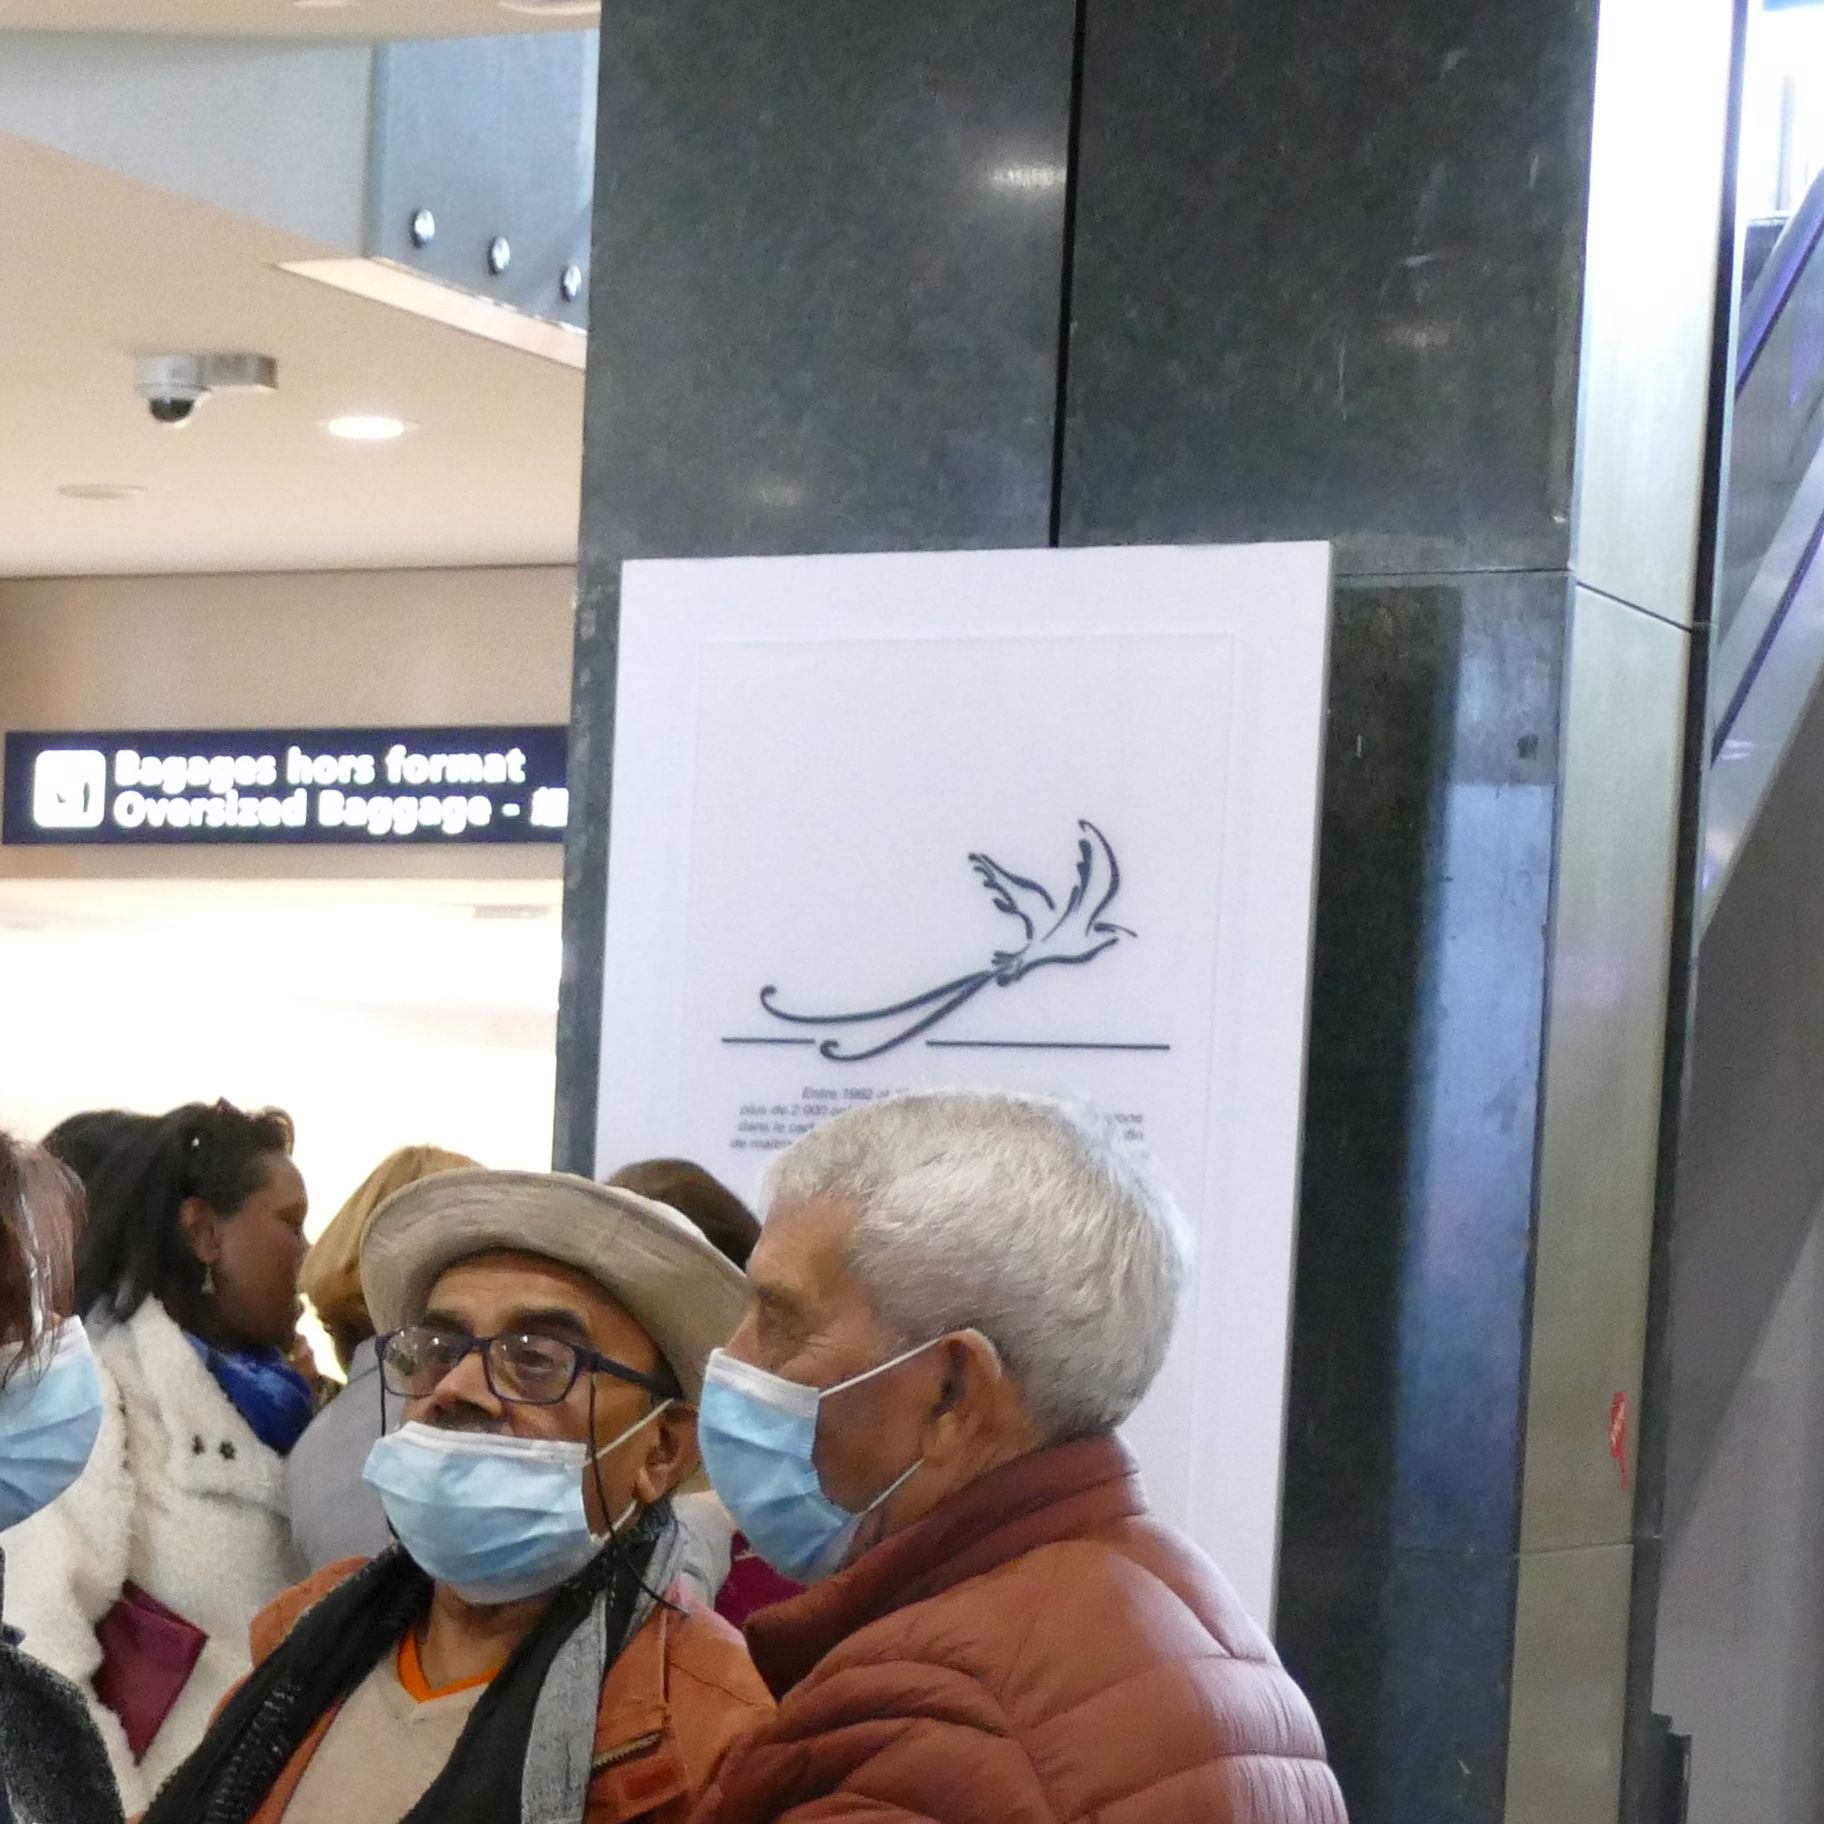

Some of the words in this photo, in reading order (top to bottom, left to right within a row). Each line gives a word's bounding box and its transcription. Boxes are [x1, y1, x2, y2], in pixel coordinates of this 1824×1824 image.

[115, 749, 277, 794] Bagages
[286, 746, 375, 785] hors
[385, 744, 526, 784] format
[114, 788, 307, 828] Oversized
[318, 788, 491, 835] Baggage
